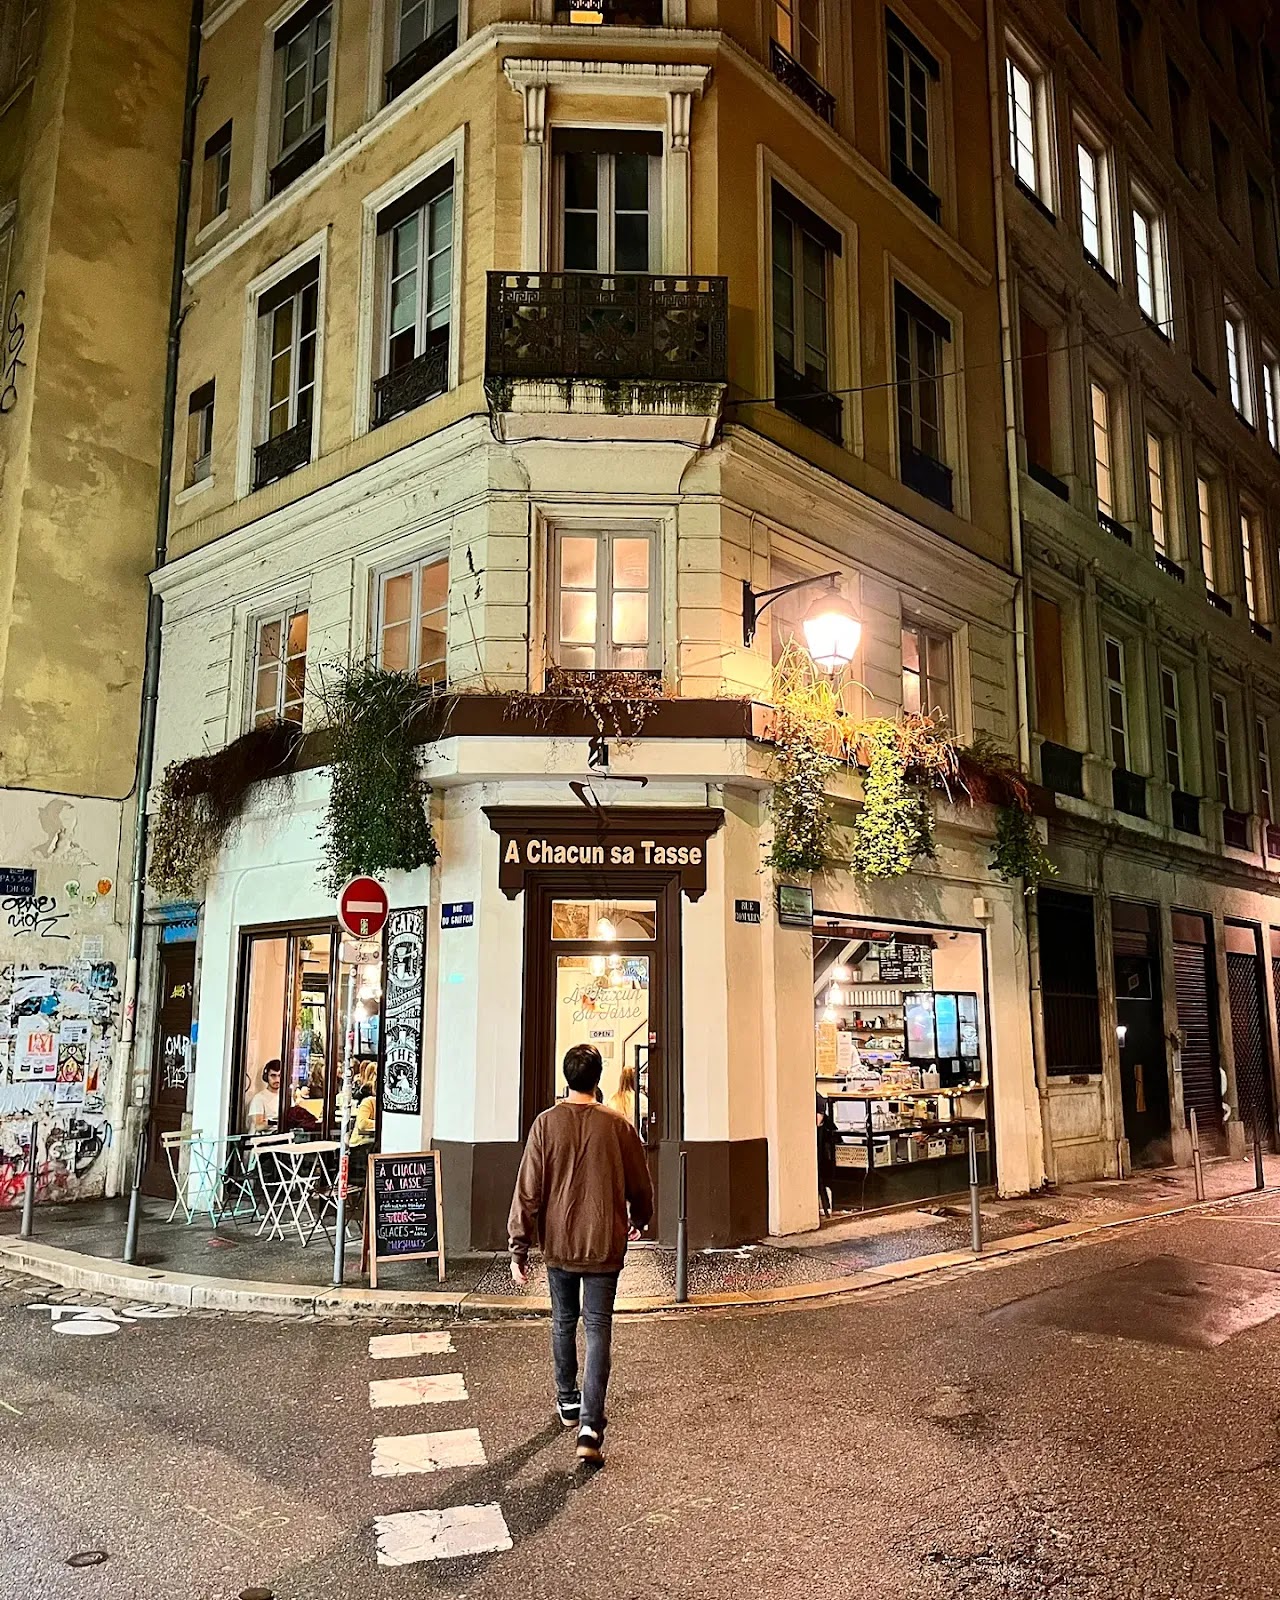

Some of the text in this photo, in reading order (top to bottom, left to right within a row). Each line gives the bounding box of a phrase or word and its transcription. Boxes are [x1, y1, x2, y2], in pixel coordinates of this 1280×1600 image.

[504, 840, 702, 865] A Chacun sa Tasse
[452, 904, 463, 913] RUE
[741, 901, 754, 911] RUE
[598, 1002, 643, 1020] Tasse
[392, 1162, 426, 1177] CHACUN
[384, 1177, 422, 1191] SA TASSE
[379, 1225, 409, 1238] GLACES
